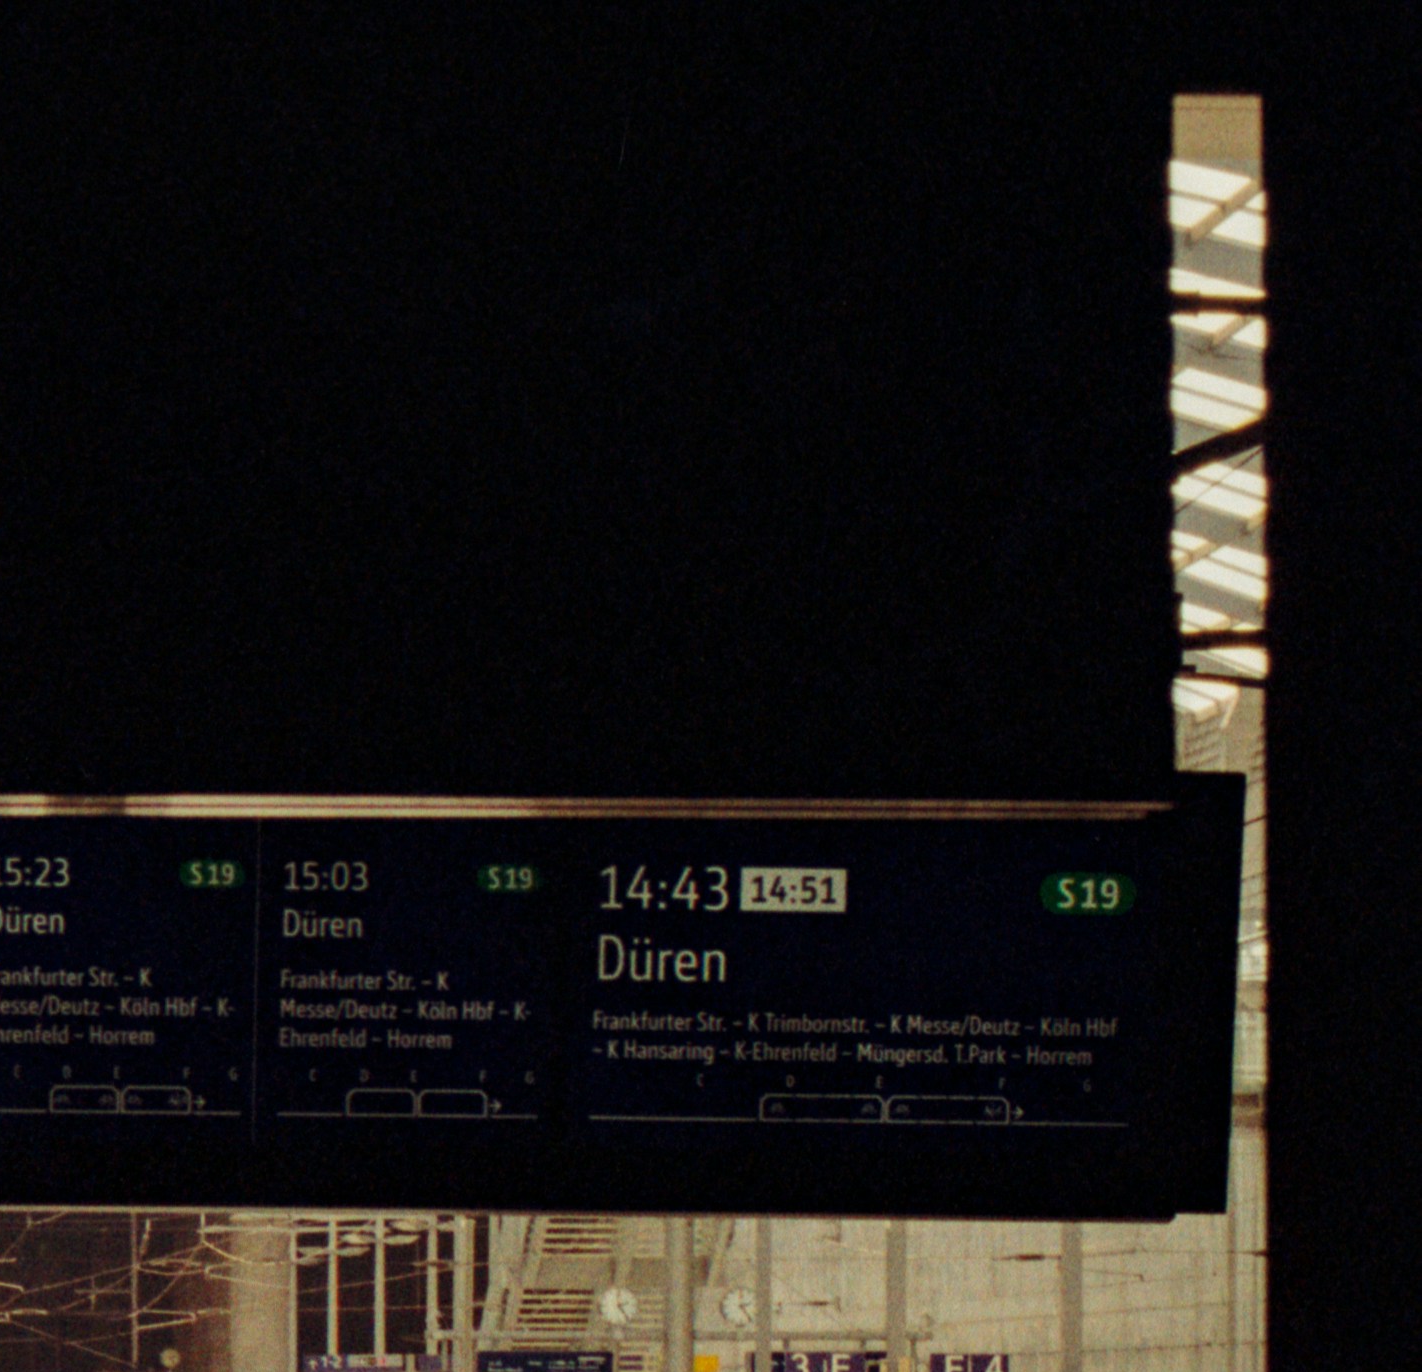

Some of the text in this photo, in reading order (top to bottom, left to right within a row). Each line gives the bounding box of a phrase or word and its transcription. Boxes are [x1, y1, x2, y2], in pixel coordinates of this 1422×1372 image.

[283, 861, 369, 891] 15:03
[600, 865, 838, 911] 14:43 14:51
[282, 908, 363, 938] Düren
[597, 933, 728, 982] Düren
[88, 965, 119, 987] Str.
[139, 967, 153, 987] K
[280, 968, 381, 990] Frankfurter
[386, 969, 416, 991] Str.
[437, 971, 449, 991] K
[120, 996, 160, 1017] Köln
[165, 996, 198, 1018] Hbf
[280, 999, 397, 1021] Messe/Deutz
[417, 1000, 457, 1021] Köln
[462, 1001, 495, 1021] Hbf
[89, 1025, 155, 1045] Horrem
[592, 1008, 692, 1031] Frankfurter
[697, 1010, 727, 1032] Str.
[748, 1012, 760, 1032] K
[765, 1012, 870, 1034] Trimbornstr.
[889, 1014, 901, 1034] K
[906, 1014, 1020, 1037] Messe/Deutz
[1039, 1016, 1081, 1037] Köln
[1086, 1017, 1119, 1038] Hbf
[279, 1027, 366, 1048] Ehrenfeld
[387, 1029, 453, 1049] Horrem
[607, 1039, 619, 1059] K
[623, 1039, 715, 1065] Hansaring
[734, 1041, 838, 1062] K-Ehrenfeld
[857, 1042, 949, 1067] Müngersd.
[1026, 1046, 1093, 1066] Horrem
